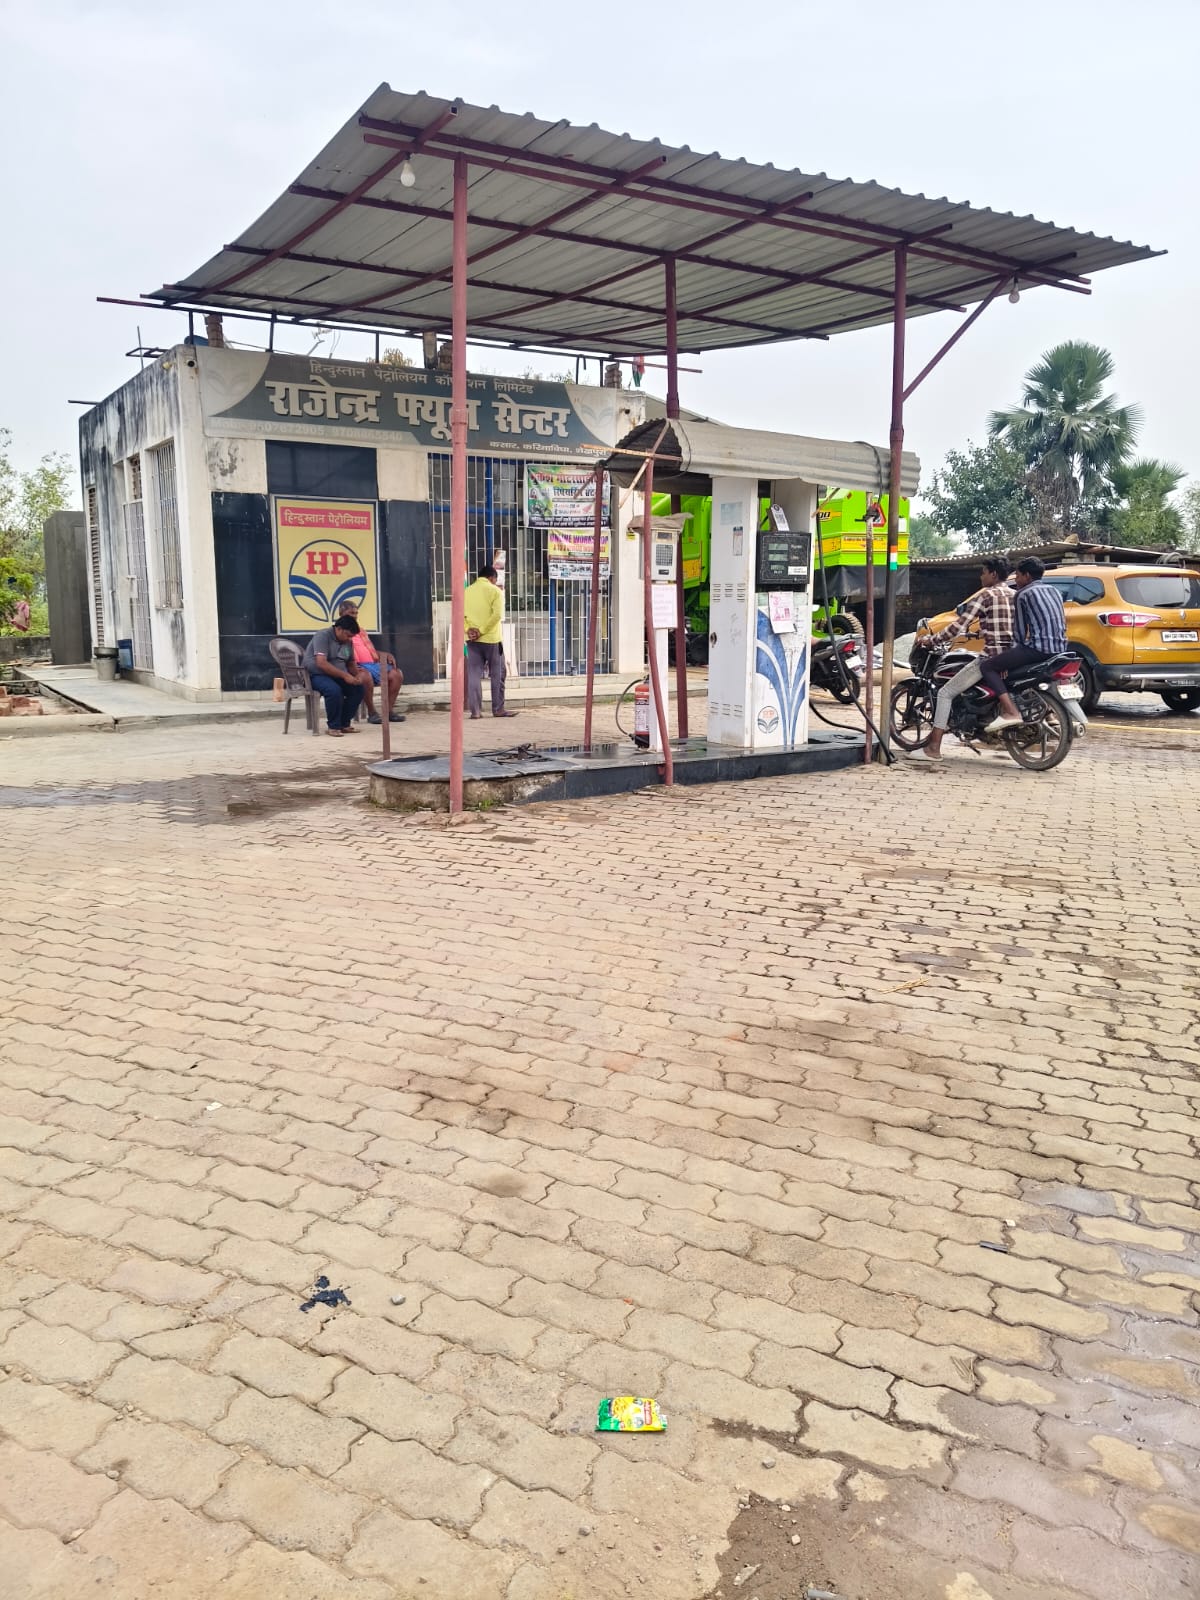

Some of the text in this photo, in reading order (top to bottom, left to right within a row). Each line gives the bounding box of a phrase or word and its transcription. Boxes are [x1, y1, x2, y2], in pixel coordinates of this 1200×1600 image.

[309, 360, 366, 378] हिन्दुस्तान
[373, 366, 428, 384] पेट्रोलियम
[493, 377, 535, 394] लिमिटेड
[264, 374, 382, 424] राजेन्द्र
[491, 393, 571, 438] सेन्टर
[284, 508, 369, 527] हिन्दुस्तान पेट्रोलियम
[305, 551, 350, 575] HP
